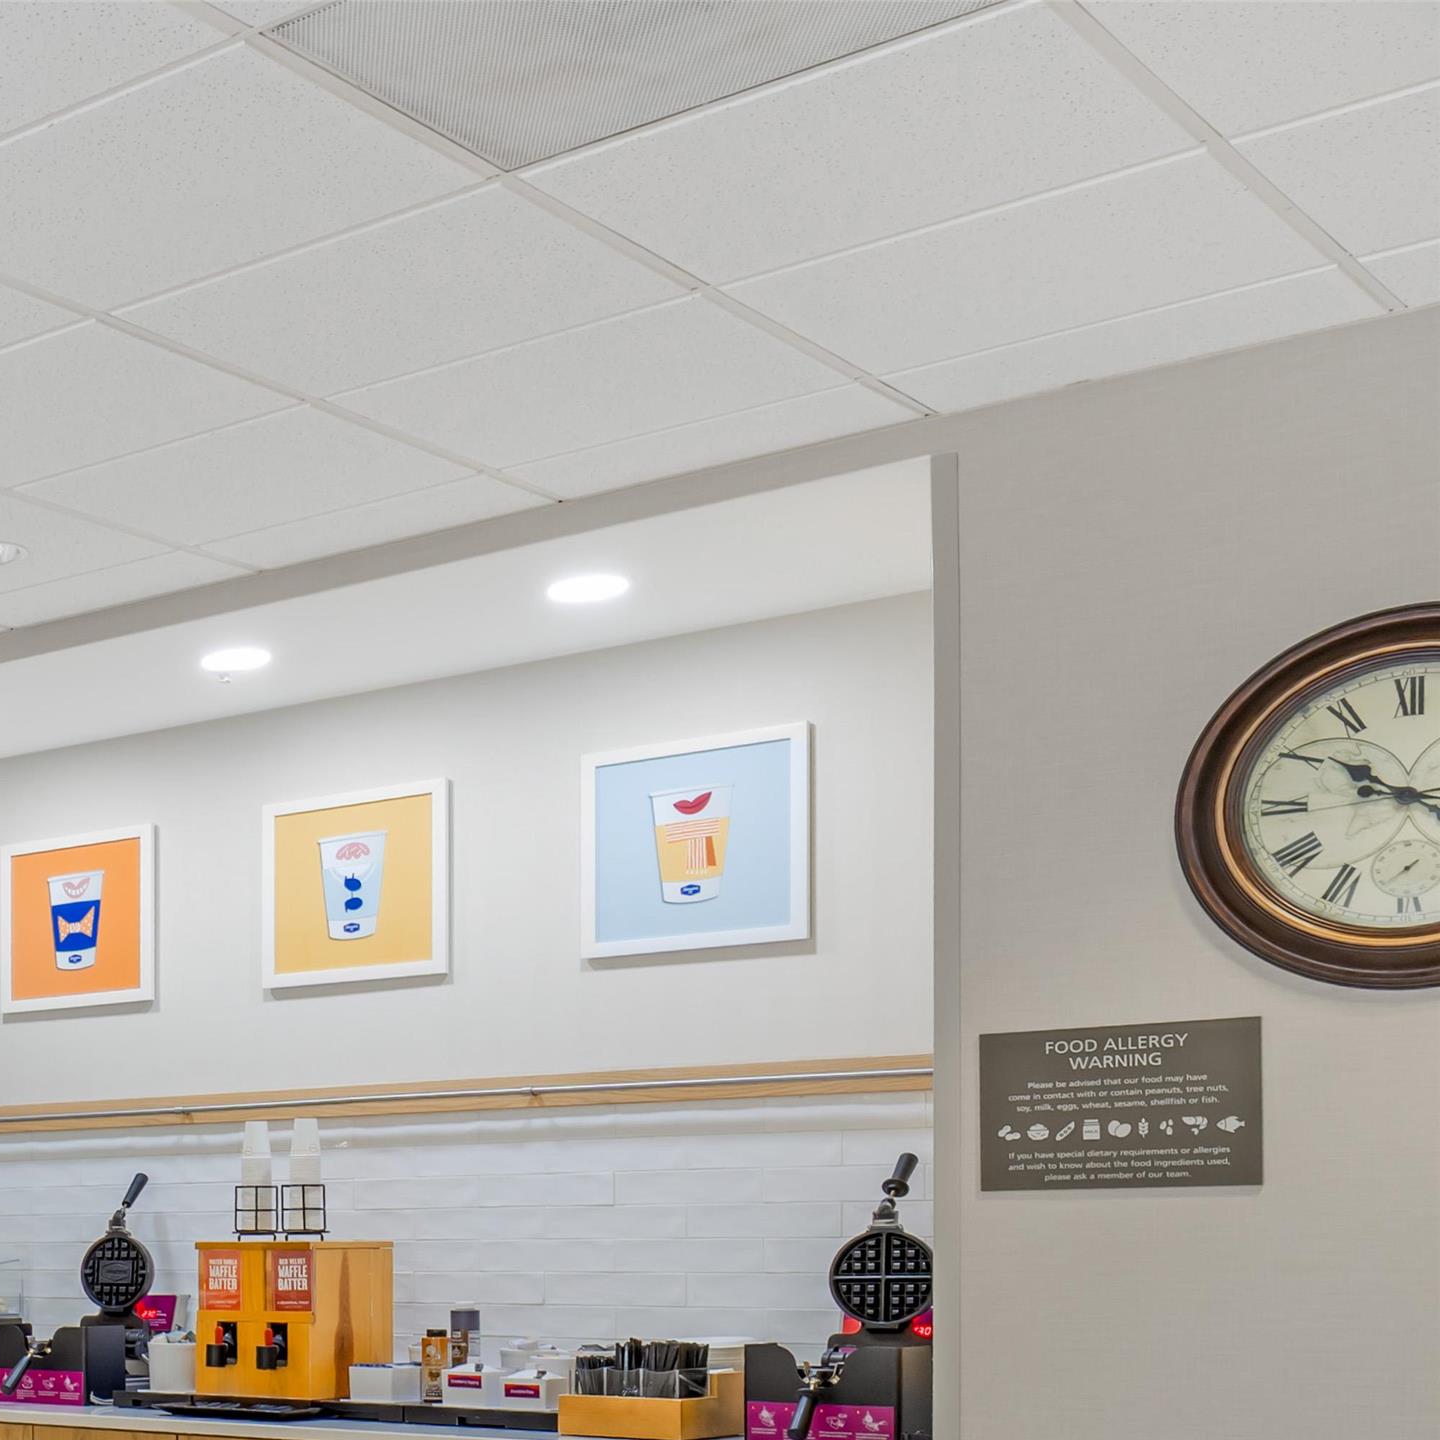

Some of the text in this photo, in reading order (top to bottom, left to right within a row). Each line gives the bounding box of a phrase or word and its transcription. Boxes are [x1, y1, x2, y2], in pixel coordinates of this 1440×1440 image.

[1045, 1033, 1188, 1054] FOOD ALLERGY
[1069, 1052, 1162, 1070] WARNING
[1069, 1079, 1101, 1087] advised
[1141, 1075, 1163, 1084] food
[1165, 1076, 1184, 1084] may
[1008, 1094, 1031, 1102] come
[1043, 1092, 1074, 1100] contact
[1076, 1090, 1096, 1098] with
[1110, 1088, 1143, 1096] contain
[1145, 1087, 1183, 1097] peanuts,
[1186, 1085, 1205, 1093] tree
[1206, 1084, 1229, 1092] nuts,
[1150, 1098, 1187, 1106] shellfish
[1008, 1152, 1015, 1160] If
[1057, 1150, 1085, 1159] special
[1087, 1150, 1118, 1158] dietary
[1120, 1148, 1178, 1157] requirements
[1193, 1146, 1231, 1155] allergies
[1026, 1162, 1046, 1170] wish
[1048, 1162, 1057, 1170] to
[1086, 1161, 1111, 1169] about
[1114, 1160, 1128, 1168] the
[1154, 1158, 1204, 1168] ingredients
[1206, 1157, 1230, 1166] used,
[1044, 1173, 1071, 1182] please
[1073, 1172, 1087, 1180] ask
[1097, 1172, 1134, 1180] member
[1136, 1170, 1146, 1178] of
[1166, 1170, 1192, 1178] team.
[209, 1265, 237, 1278] WAFFLE
[278, 1265, 308, 1278] WAFFLE
[209, 1278, 237, 1291] BATTER
[278, 1278, 308, 1291] BATTER
